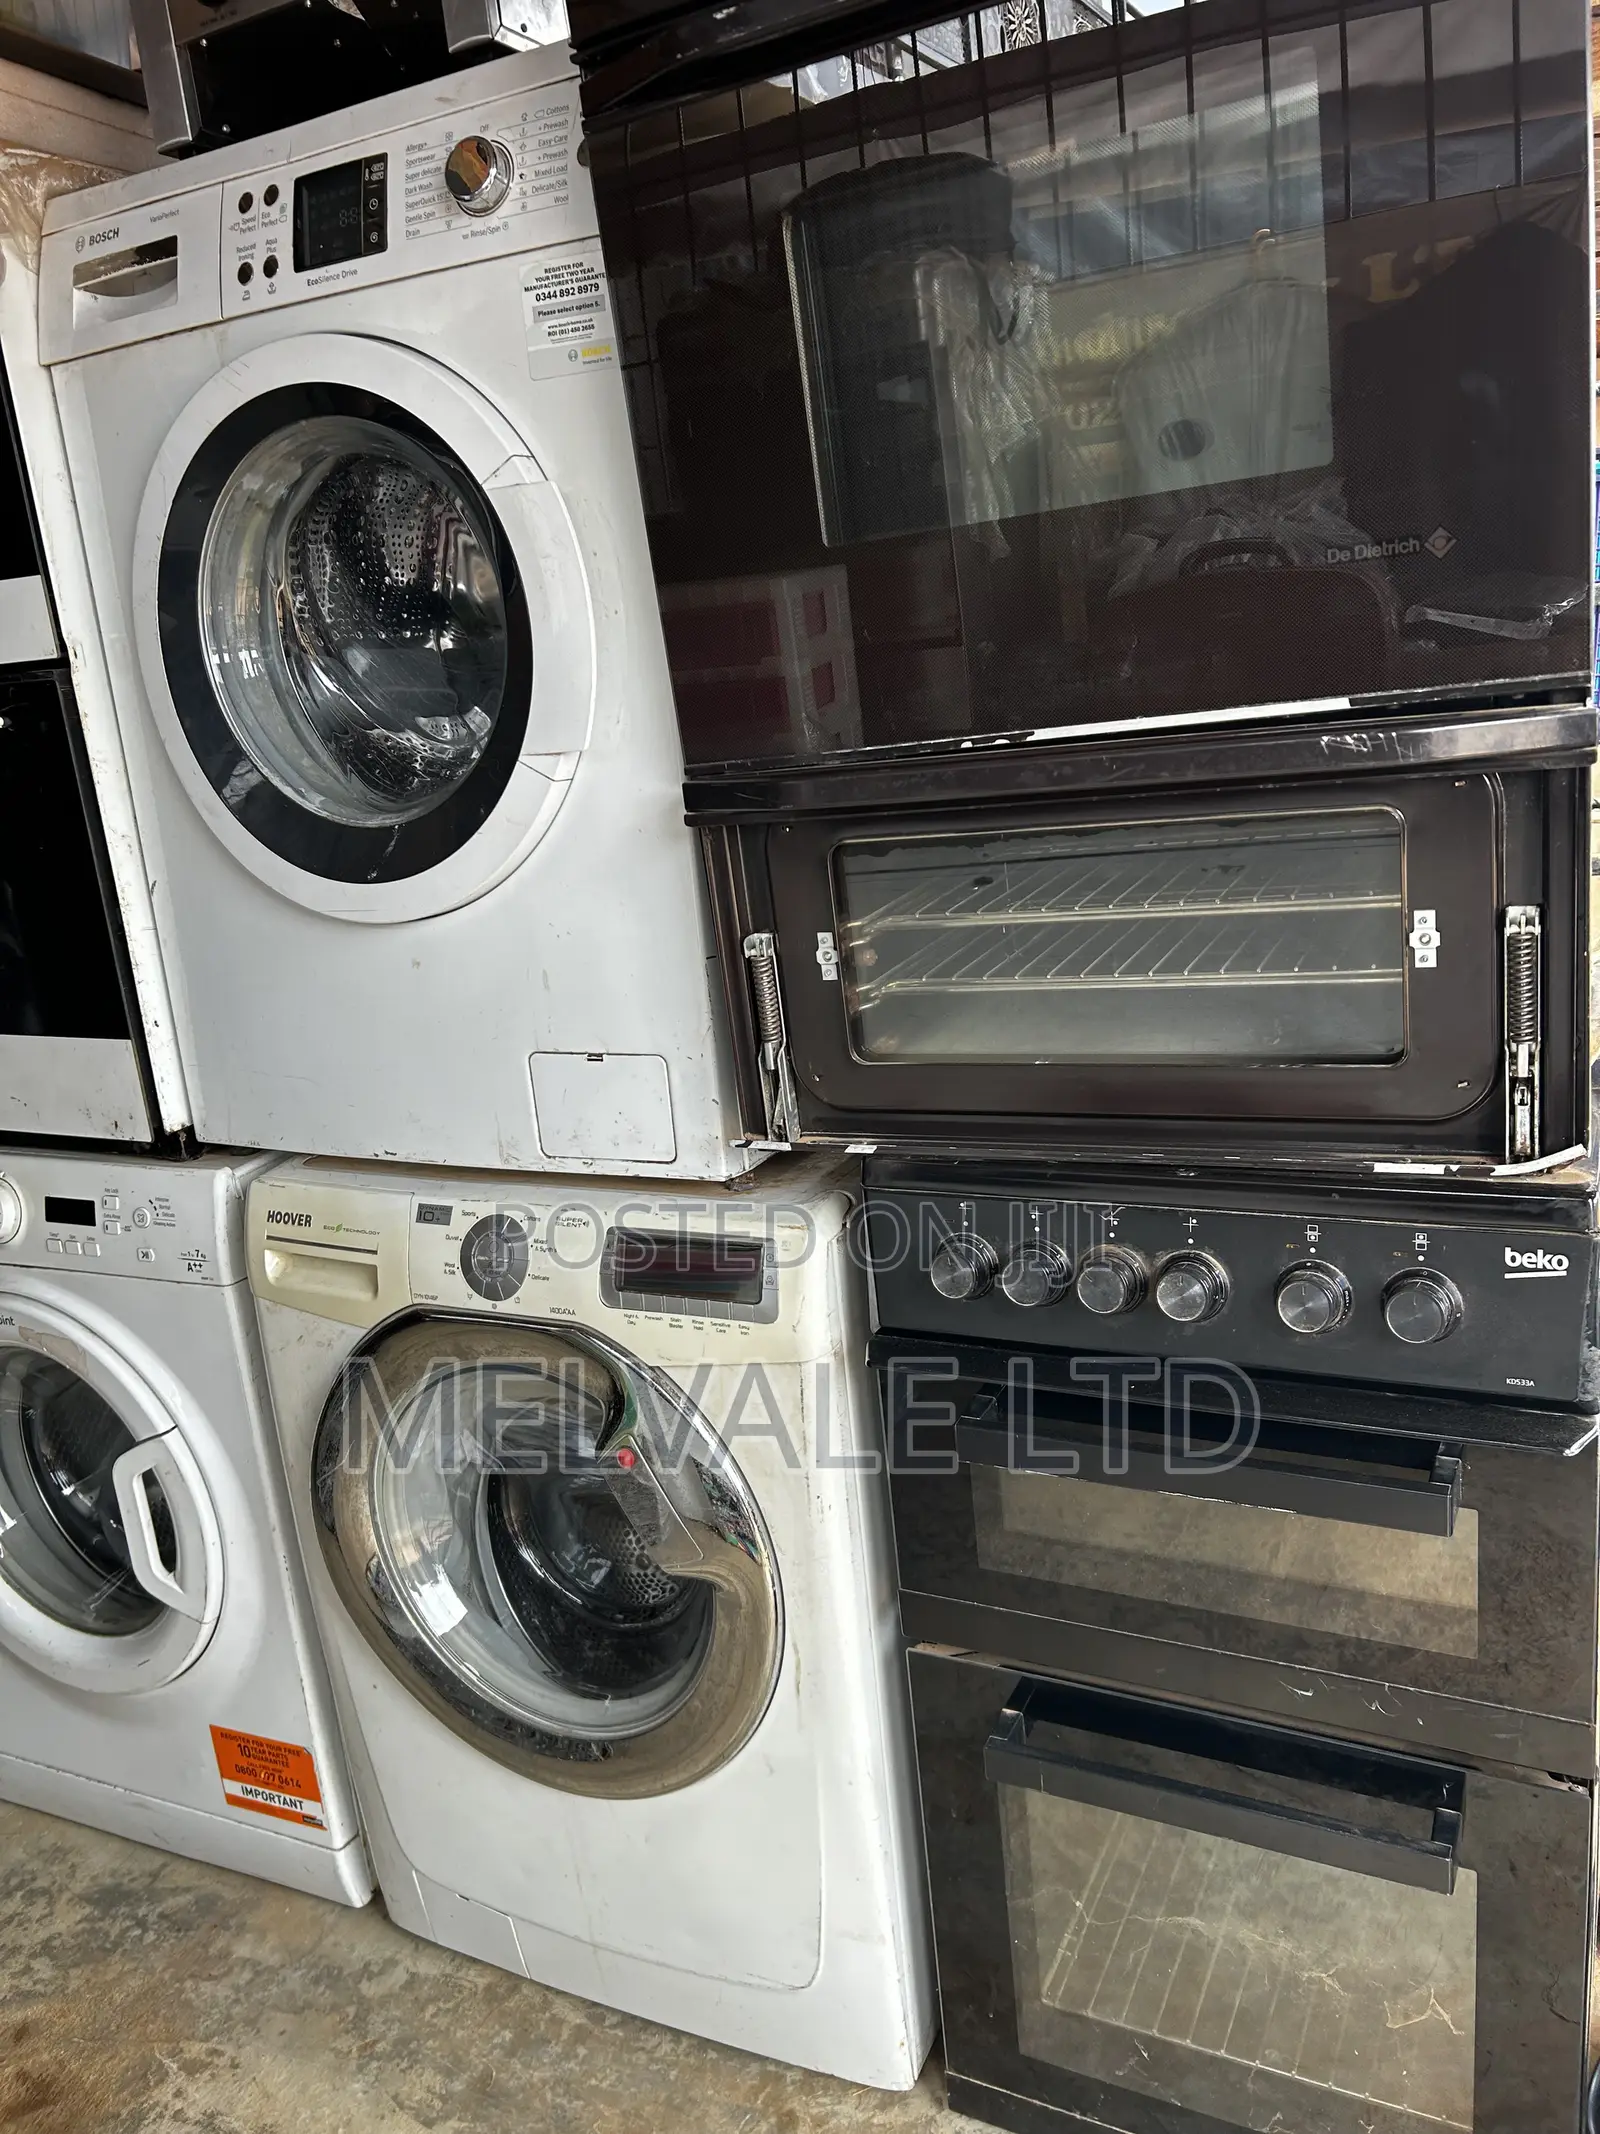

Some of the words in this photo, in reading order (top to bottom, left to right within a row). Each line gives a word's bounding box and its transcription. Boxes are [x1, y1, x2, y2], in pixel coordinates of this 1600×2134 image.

[546, 104, 569, 116] Cottons
[480, 124, 489, 133] Off
[543, 119, 568, 130] Prewash
[405, 152, 436, 167] Sportswear
[542, 149, 568, 161] Prewash
[405, 171, 420, 182] Super
[420, 166, 442, 178] delicate
[534, 166, 552, 178] Mixed
[552, 163, 568, 174] Load
[405, 184, 418, 195] Dark
[418, 181, 433, 193] Wash
[531, 179, 568, 195] Delicate/Silk
[405, 195, 436, 210] SuperQuick
[553, 194, 569, 204] Wool
[241, 215, 257, 226] Speed
[261, 211, 271, 220] Eco
[405, 213, 422, 225] Gentle
[423, 210, 436, 221] Spin
[239, 224, 257, 236] Perfect
[261, 218, 279, 230] Perfect
[89, 227, 120, 247] BOSCH
[405, 228, 420, 239] Drain
[470, 225, 502, 238] Rinse/Spin
[236, 242, 257, 254] Reduced
[265, 237, 278, 246] Aqua
[266, 245, 277, 254] Plus
[544, 264, 572, 275] REGISTER
[572, 261, 584, 270] FOR
[306, 273, 341, 288] EcoSilence
[341, 268, 358, 280] Drive
[535, 275, 551, 284] YOUR
[551, 272, 565, 281] FREE
[566, 269, 579, 278] TWO
[579, 266, 595, 276] YEAR
[524, 278, 574, 293] MANUFACTURER'S
[535, 289, 558, 303] 0344
[559, 286, 576, 299] 892
[577, 282, 600, 295] 8979
[537, 308, 557, 318] Please
[557, 305, 575, 315] select
[575, 301, 594, 313] option
[547, 329, 558, 338] ROI
[1326, 547, 1351, 564] De
[1354, 537, 1421, 561] Dietrich
[266, 1209, 313, 1228] HOOVER
[461, 1209, 477, 1217] Sports
[342, 1226, 381, 1236] TECHNOLOGY
[555, 1221, 582, 1229] SILENT
[194, 1249, 200, 1258] 7
[1504, 1246, 1570, 1271] beko
[187, 1262, 204, 1273] A++
[531, 1273, 550, 1282] Delicate
[738, 1323, 750, 1331] Easy
[220, 1731, 251, 1746] REGISTER
[251, 1739, 264, 1748] FOR
[266, 1743, 282, 1753] YOUR
[283, 1747, 301, 1757] FREE
[237, 1743, 252, 1758] 10
[251, 1746, 266, 1756] YEAR
[268, 1750, 289, 1762] PARTS
[252, 1753, 290, 1768] GUARANTEE
[234, 1763, 258, 1778] 0800
[278, 1775, 302, 1789] 0614
[240, 1784, 304, 1811] IMPORTANT
